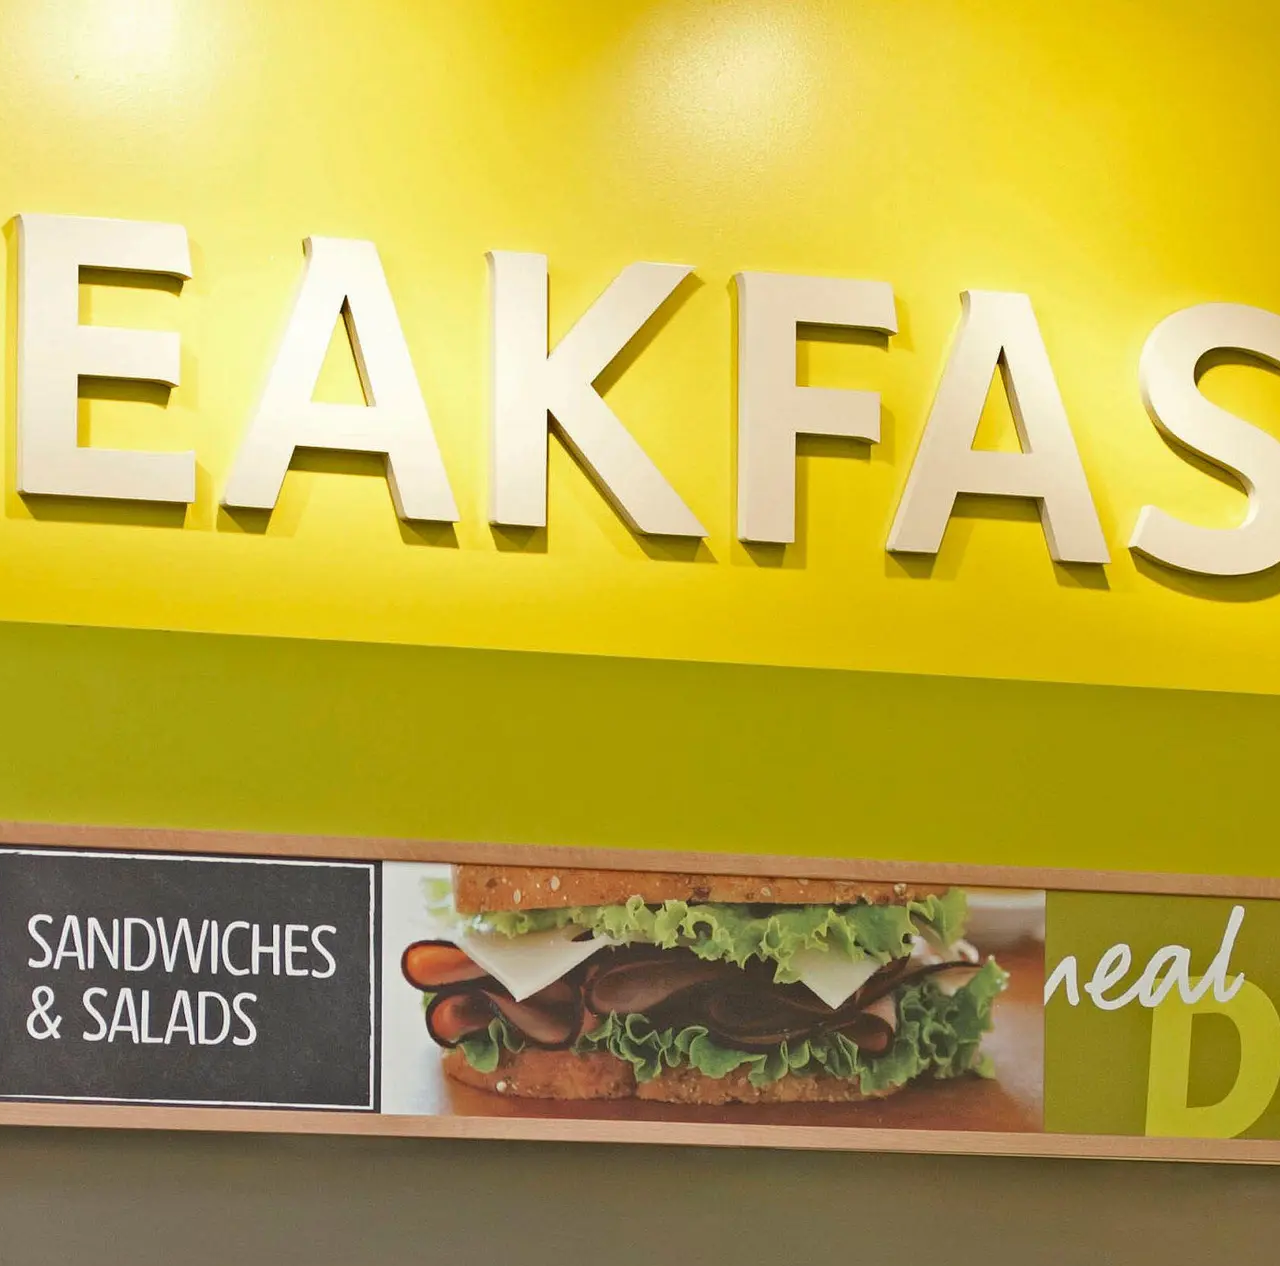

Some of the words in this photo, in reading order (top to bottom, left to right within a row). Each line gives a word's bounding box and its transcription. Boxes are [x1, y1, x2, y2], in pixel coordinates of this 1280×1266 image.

[27, 914, 338, 978] SANDWICHES
[26, 985, 63, 1040] &
[82, 987, 259, 1046] SALADS
